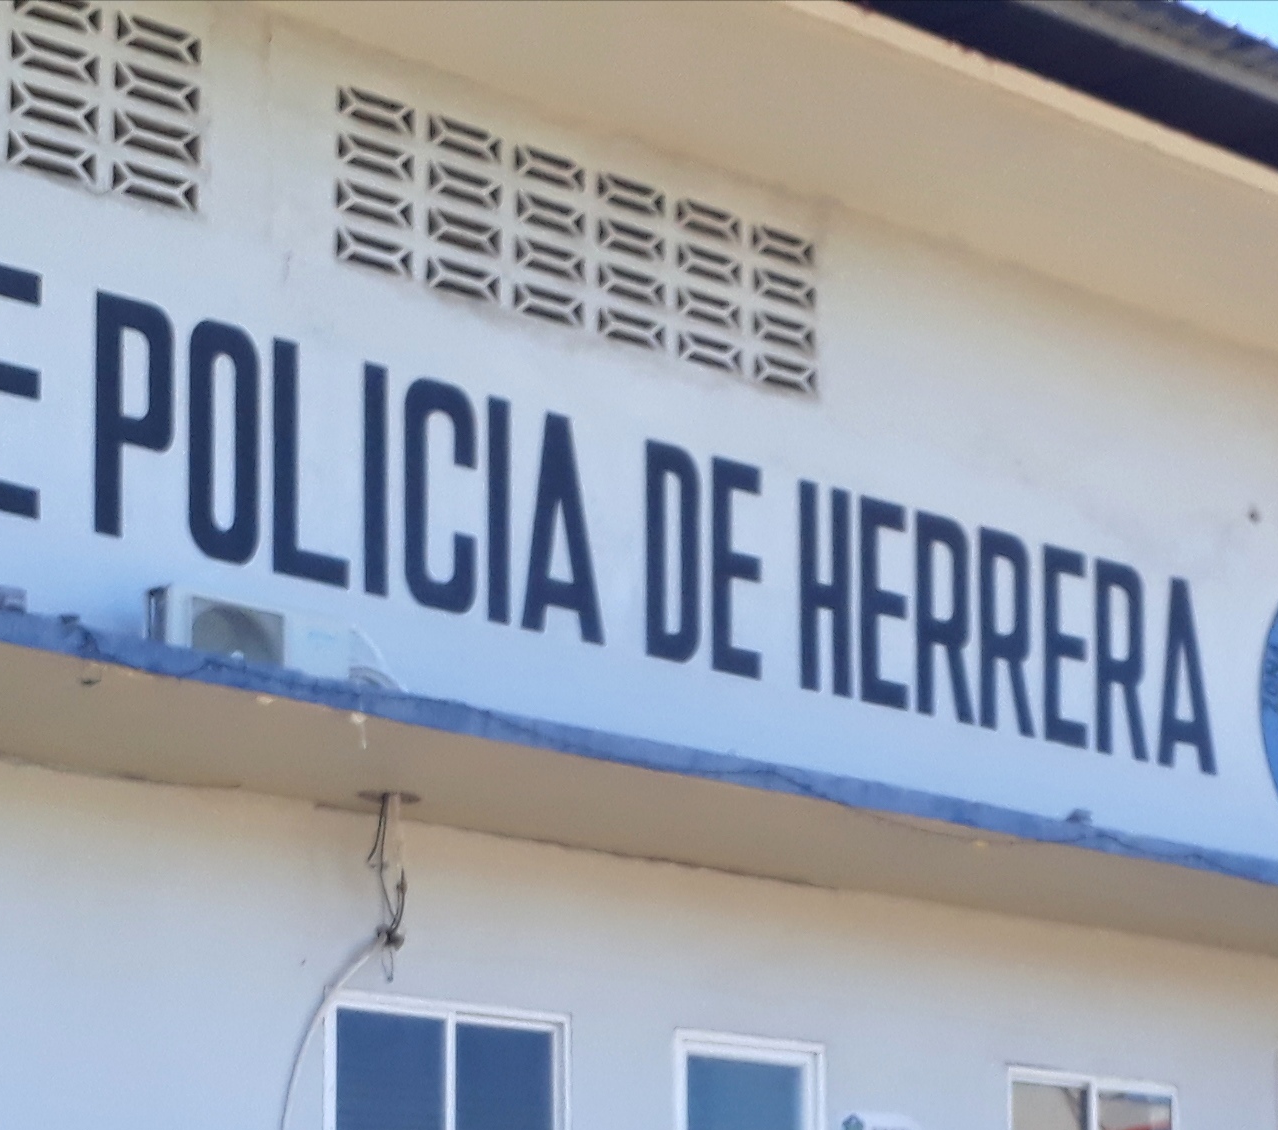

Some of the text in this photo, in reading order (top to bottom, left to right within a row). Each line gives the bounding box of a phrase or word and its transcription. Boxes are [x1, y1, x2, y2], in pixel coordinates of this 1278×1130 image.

[94, 289, 606, 647] POLICIA
[644, 437, 763, 681] DE
[798, 478, 1218, 776] HERRERA
